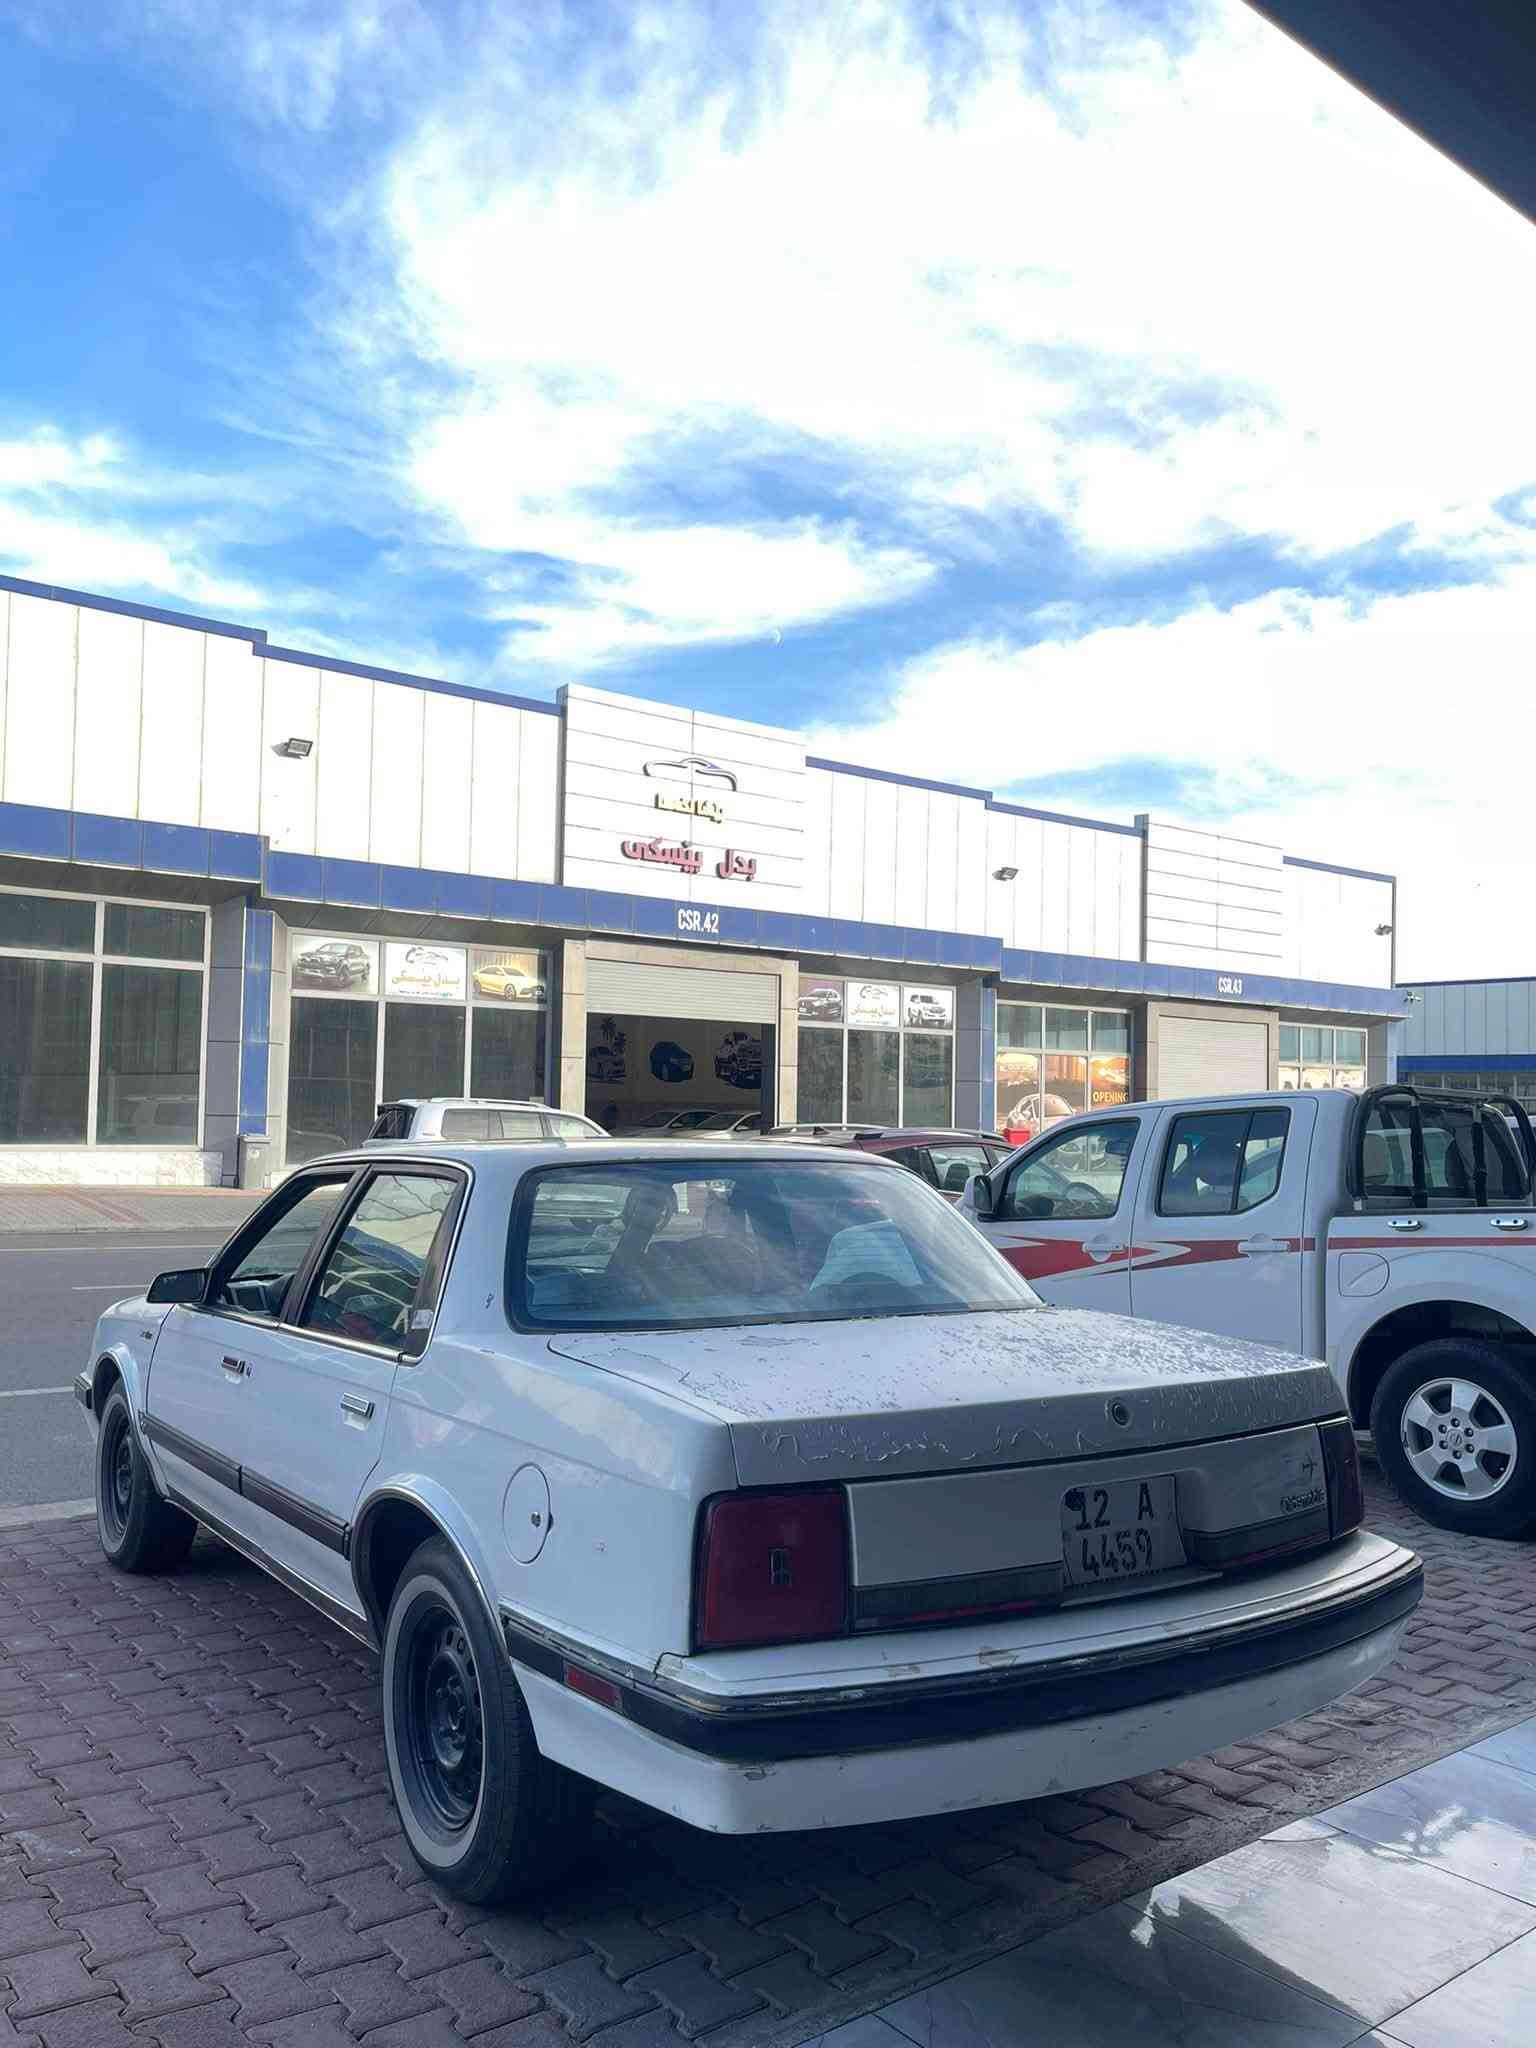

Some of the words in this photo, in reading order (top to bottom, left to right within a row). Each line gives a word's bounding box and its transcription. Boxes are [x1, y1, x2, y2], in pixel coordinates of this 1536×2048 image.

[678, 908, 719, 933] CSR.42
[1137, 1482, 1154, 1520] A
[1081, 1527, 1151, 1576] 4459
